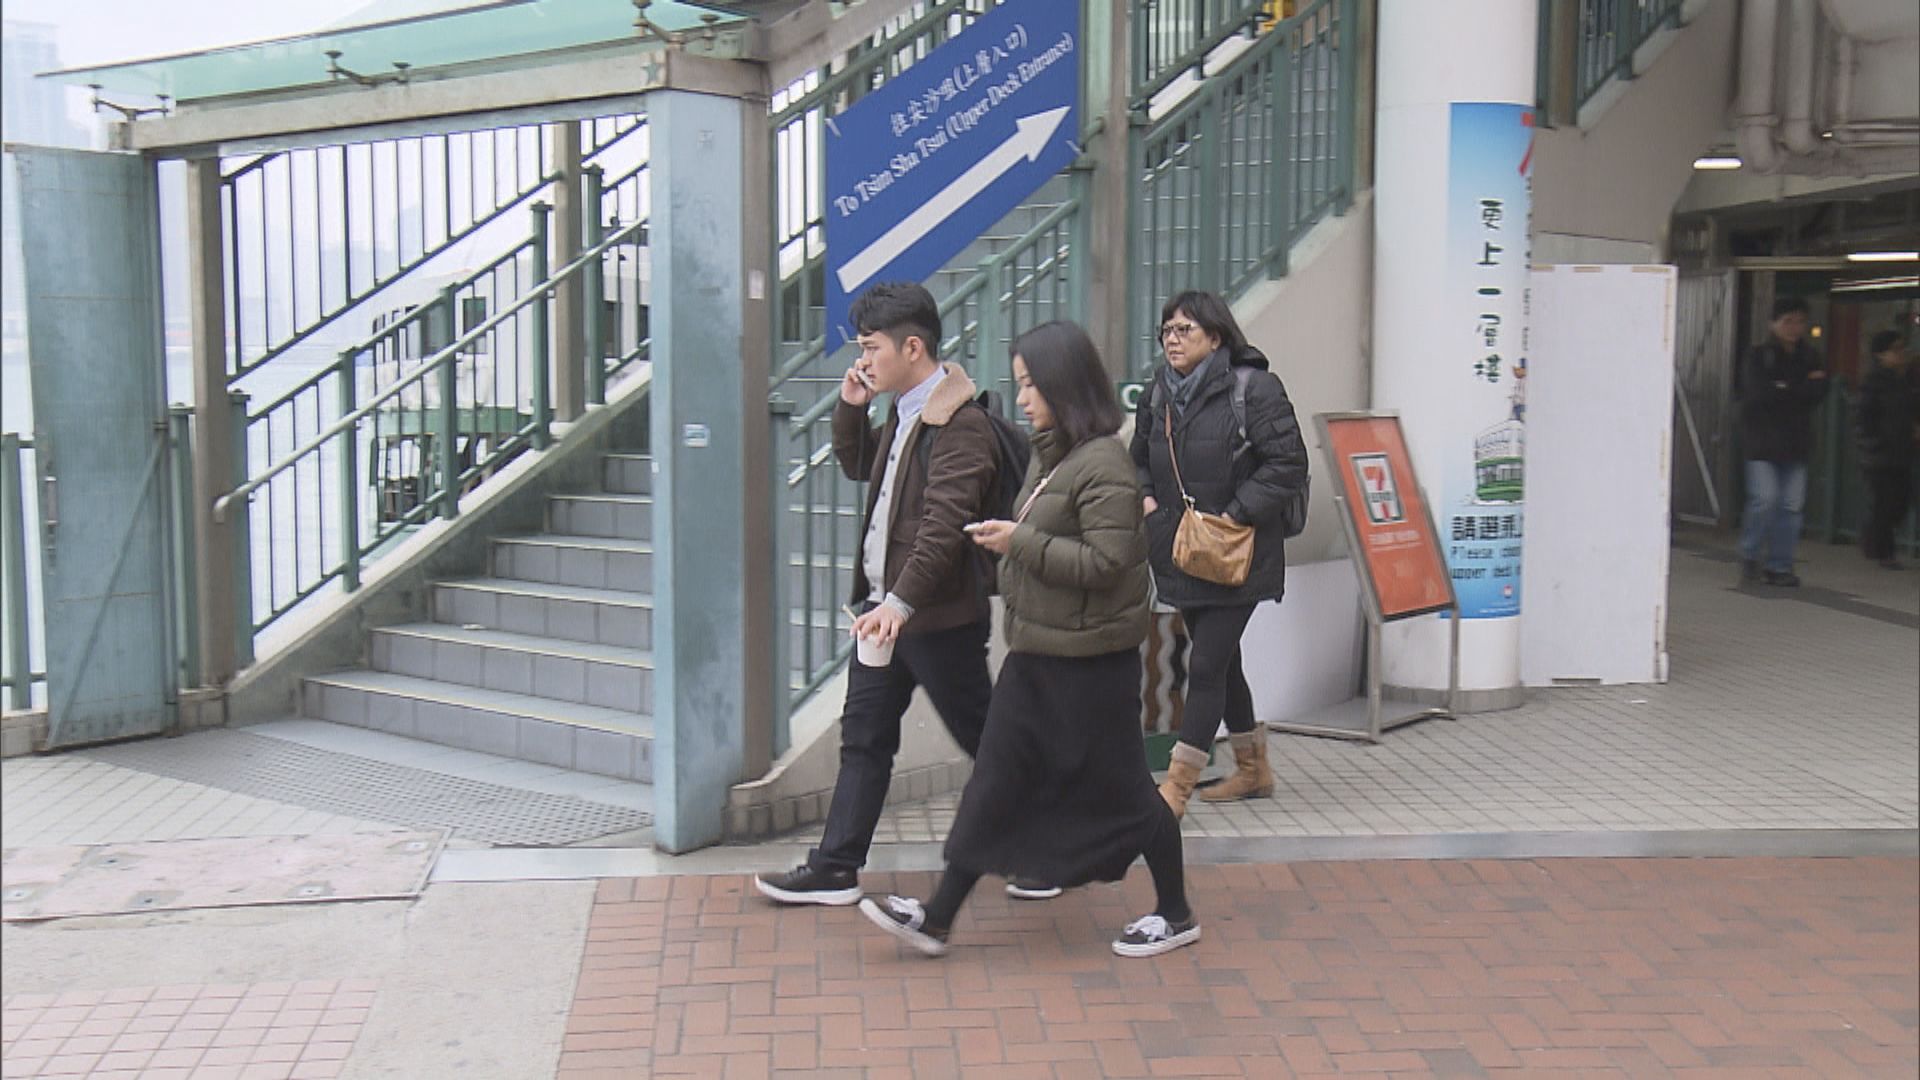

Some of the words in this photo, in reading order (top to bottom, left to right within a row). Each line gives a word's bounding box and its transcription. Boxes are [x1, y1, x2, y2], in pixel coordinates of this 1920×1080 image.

[834, 195, 859, 217] To
[854, 170, 895, 201] Tsim
[890, 152, 920, 177] Sha
[914, 125, 949, 157] Tsui
[945, 98, 990, 139] (Upper
[987, 72, 1022, 106] Deck
[1017, 32, 1073, 83] Entrance)
[1362, 466, 1390, 519] 7
